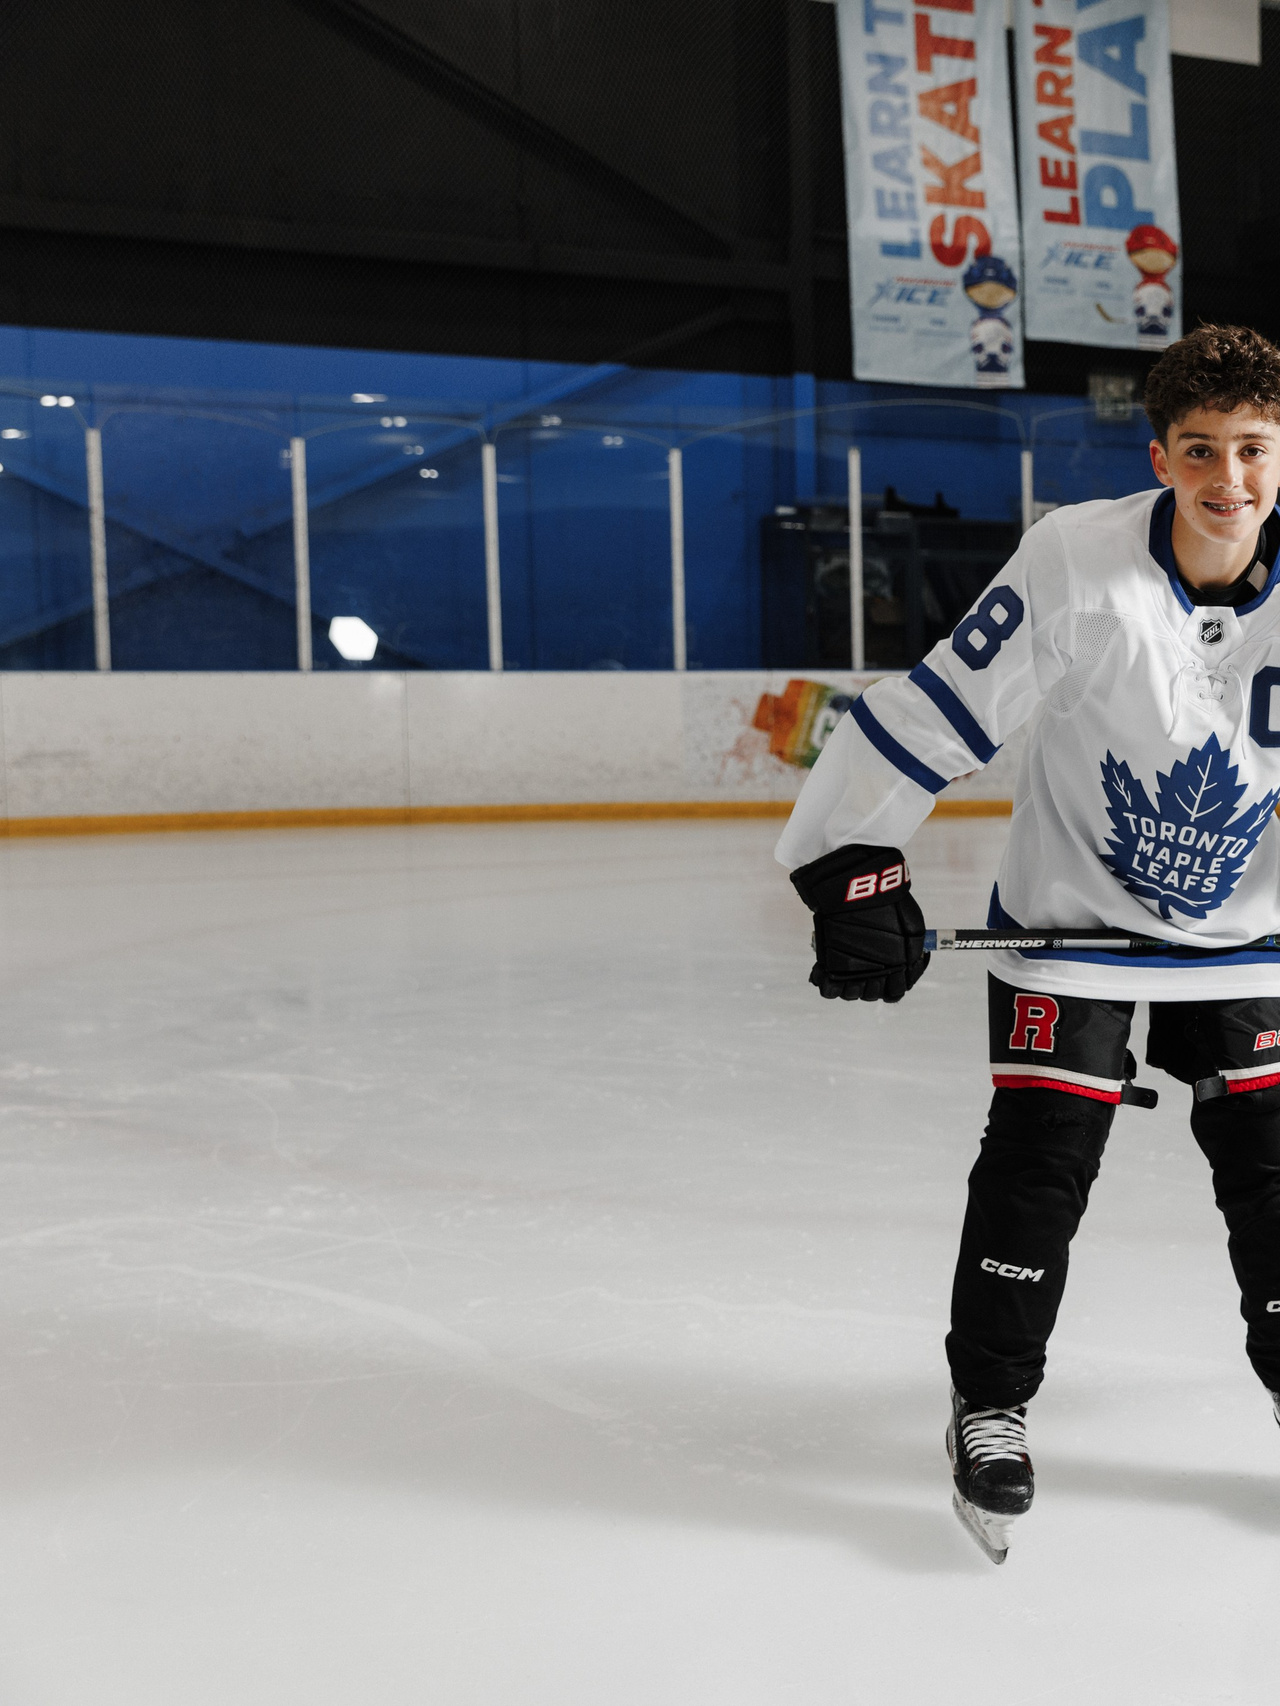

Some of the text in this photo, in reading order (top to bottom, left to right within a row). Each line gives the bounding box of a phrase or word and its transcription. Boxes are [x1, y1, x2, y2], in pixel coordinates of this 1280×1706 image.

[862, 0, 906, 35] T
[1033, 23, 1081, 226] LEARN
[1075, 0, 1155, 232] PLA
[864, 52, 922, 260] LEARN
[952, 585, 1024, 671] 8
[1203, 625, 1220, 641] NHL
[1123, 812, 1248, 859] TORONTO
[1136, 836, 1226, 874] MAPLE
[1132, 853, 1219, 893] LEAFS
[1009, 993, 1060, 1053] R
[980, 1257, 1045, 1282] CCM
